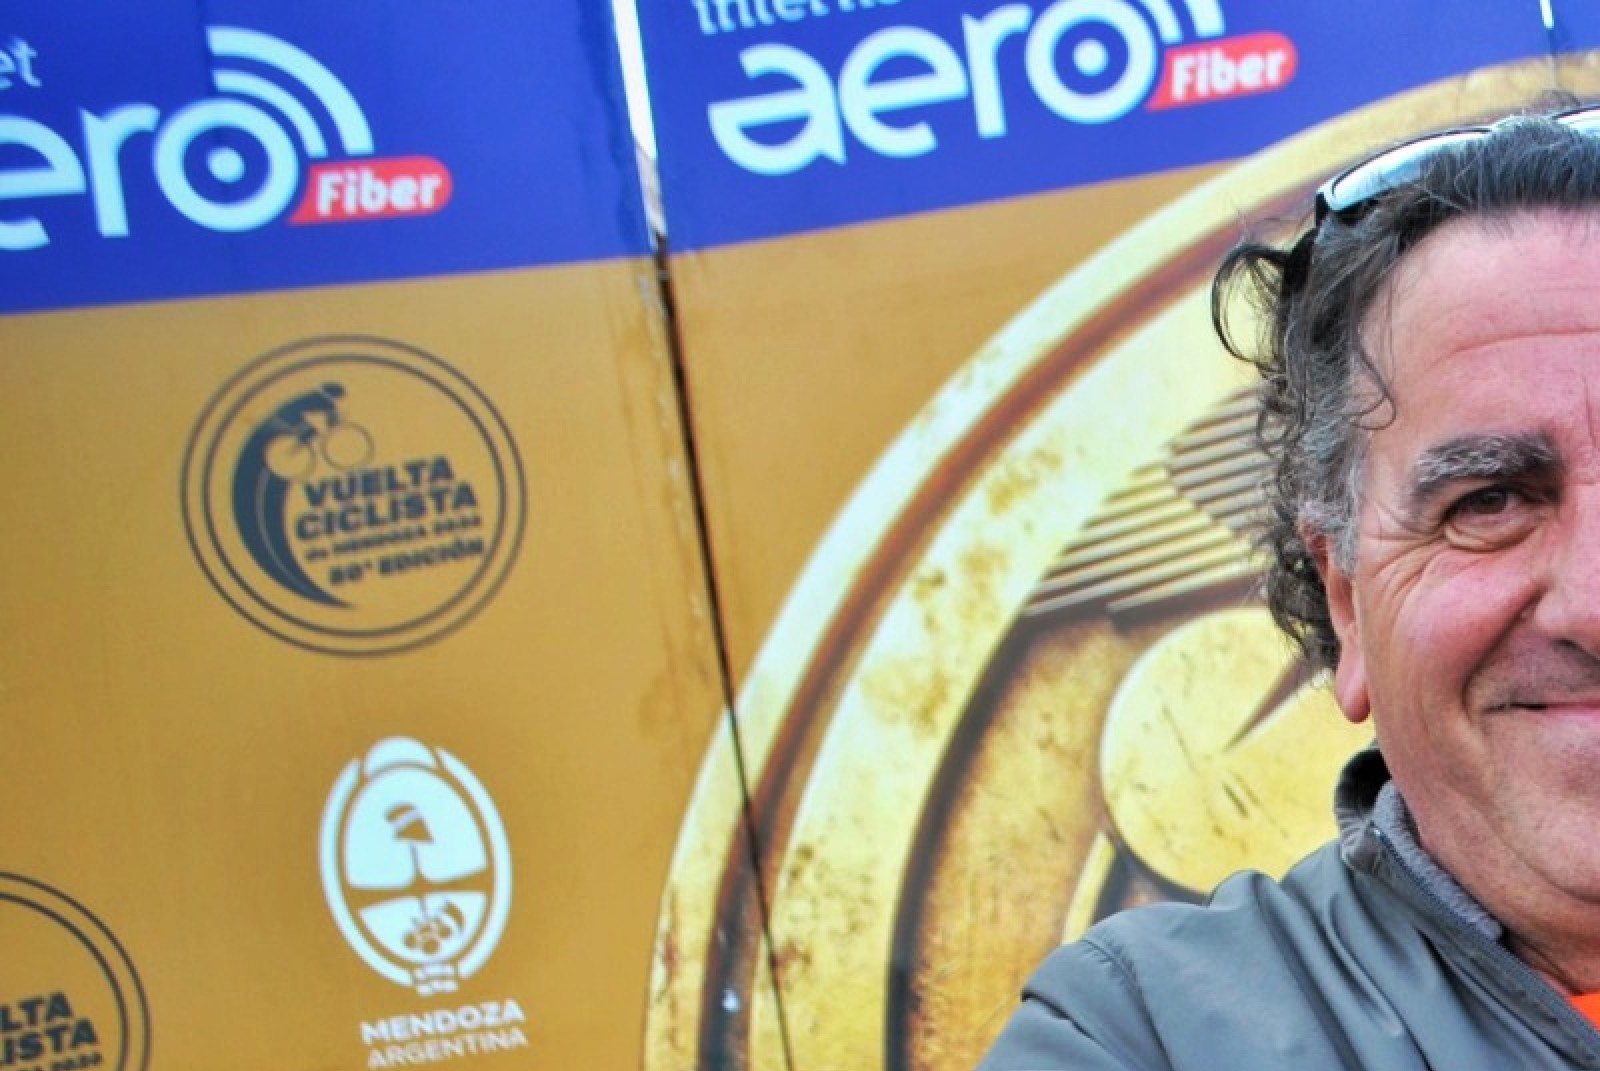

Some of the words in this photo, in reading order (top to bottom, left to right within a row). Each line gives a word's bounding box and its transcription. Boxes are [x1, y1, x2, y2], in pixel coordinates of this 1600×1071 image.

[707, 0, 1157, 176] aero
[1172, 47, 1288, 101] Fiber
[316, 171, 440, 216] Fiber
[304, 455, 454, 507] VUELTA
[295, 480, 477, 540] CICLISTA
[360, 998, 527, 1047] MENDOZA
[368, 1026, 530, 1071] ARGENTINA
